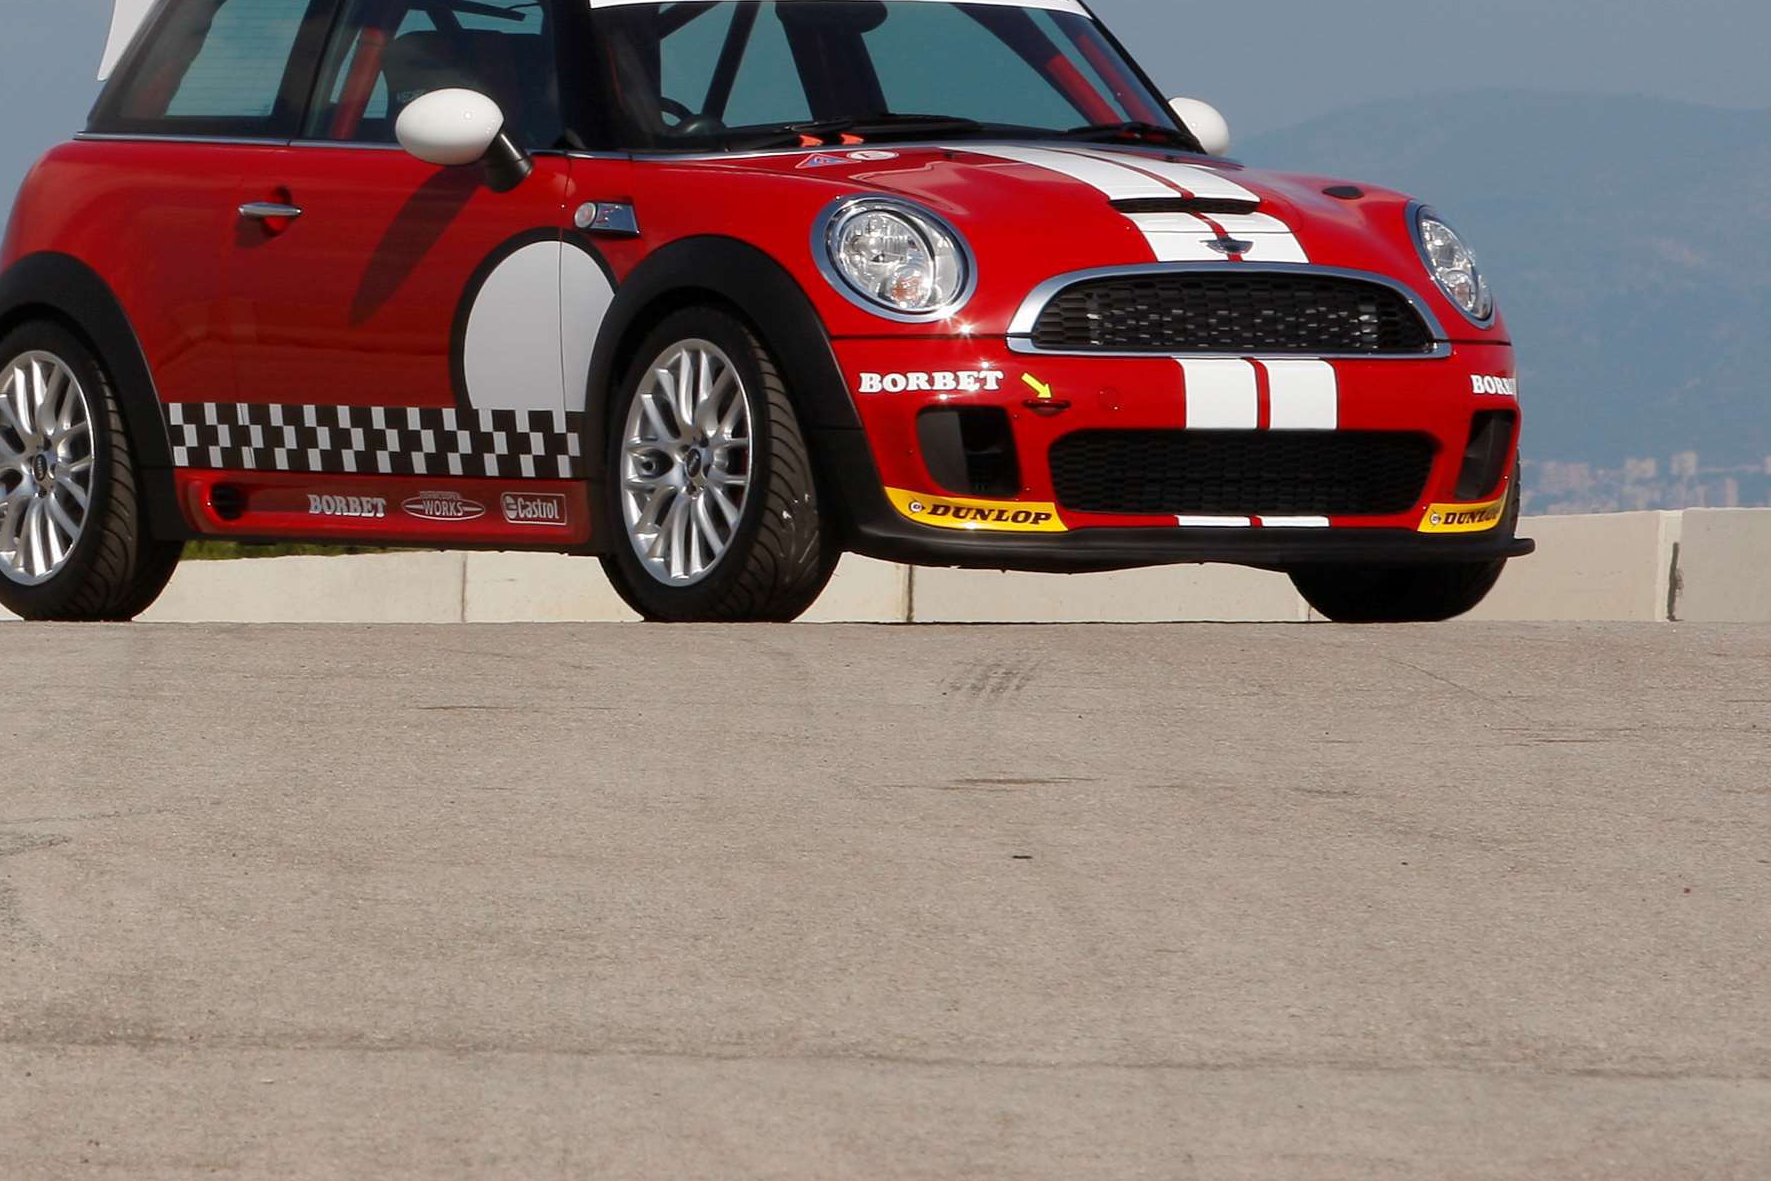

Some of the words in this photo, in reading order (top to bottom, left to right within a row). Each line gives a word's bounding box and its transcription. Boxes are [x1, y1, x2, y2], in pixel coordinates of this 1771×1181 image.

[858, 371, 1004, 393] BORBET
[307, 494, 386, 517] BORBET
[422, 500, 464, 516] WORKS
[517, 497, 560, 519] Castrol
[928, 503, 1052, 525] DUNLOP
